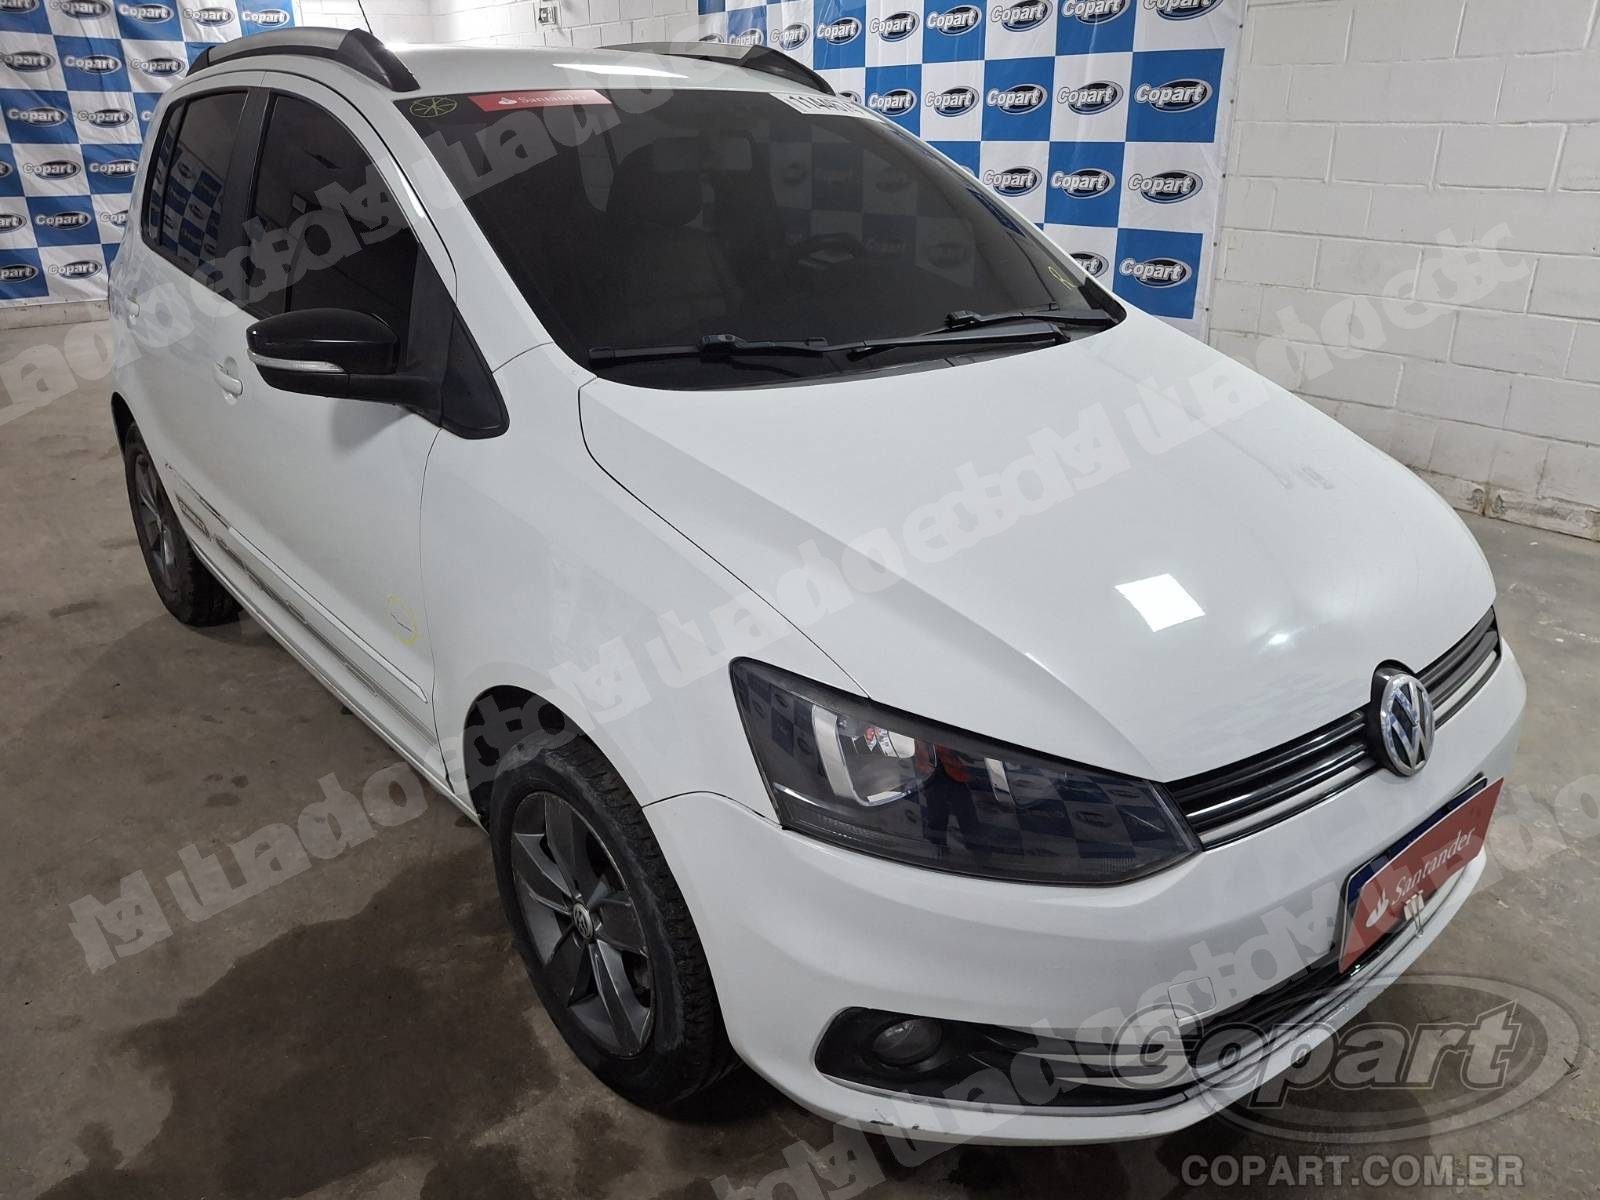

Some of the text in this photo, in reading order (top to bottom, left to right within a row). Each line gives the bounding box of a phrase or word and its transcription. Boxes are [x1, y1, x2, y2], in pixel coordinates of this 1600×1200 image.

[50, 0, 102, 13] Copart
[119, 4, 169, 21] Copart
[990, 2, 1047, 24] Copart
[1061, 0, 1121, 19] Copart
[184, 9, 228, 23] Copart
[241, 10, 285, 24] Copart
[926, 9, 976, 31] Copart
[816, 21, 857, 40] Copart
[870, 15, 914, 34] Copart
[770, 27, 804, 43] Copart
[0, 53, 47, 67] opart
[64, 56, 115, 71] Copart
[131, 58, 178, 72] Copart
[868, 92, 911, 110] Copart
[925, 89, 972, 109] Copart
[987, 88, 1041, 108] Copart
[1057, 86, 1115, 107] Copart
[1135, 83, 1208, 106] Copart
[8, 108, 60, 122] Copart
[78, 111, 125, 122] Copart
[23, 163, 73, 176] Copart
[89, 162, 137, 175] Copart
[983, 169, 1034, 190] Copart
[1051, 171, 1107, 191] Copart
[1128, 174, 1192, 195] Copart
[0, 215, 18, 226] art
[35, 213, 84, 227] Copart
[100, 212, 127, 226] Cop
[0, 267, 32, 279] part
[48, 262, 95, 277] Copart
[1119, 258, 1182, 280] Copart
[1392, 828, 1476, 905] Santander
